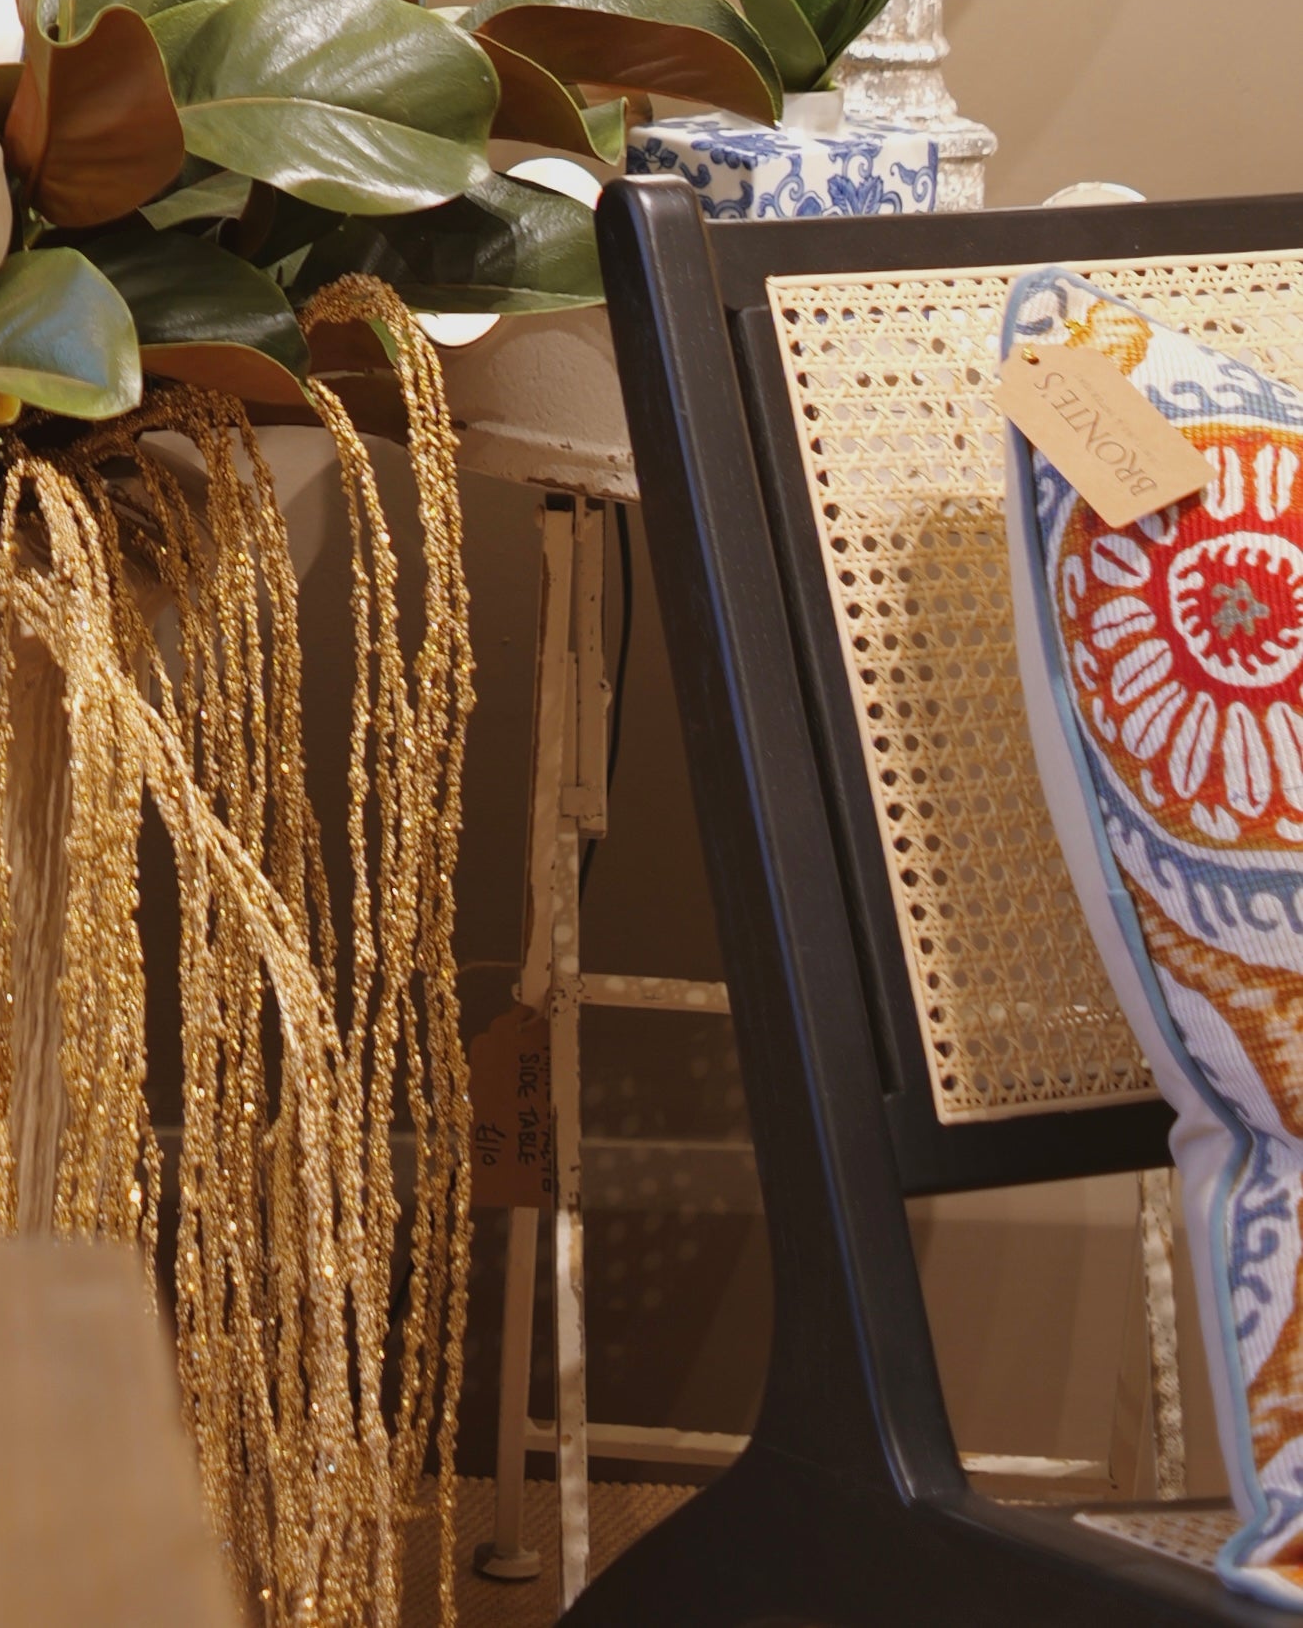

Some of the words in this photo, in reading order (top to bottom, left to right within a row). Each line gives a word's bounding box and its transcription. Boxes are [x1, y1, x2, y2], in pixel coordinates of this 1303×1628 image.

[1033, 372, 1157, 497] BRONTE'S
[517, 1053, 539, 1098] SIDE
[517, 1106, 539, 1166] TABLE
